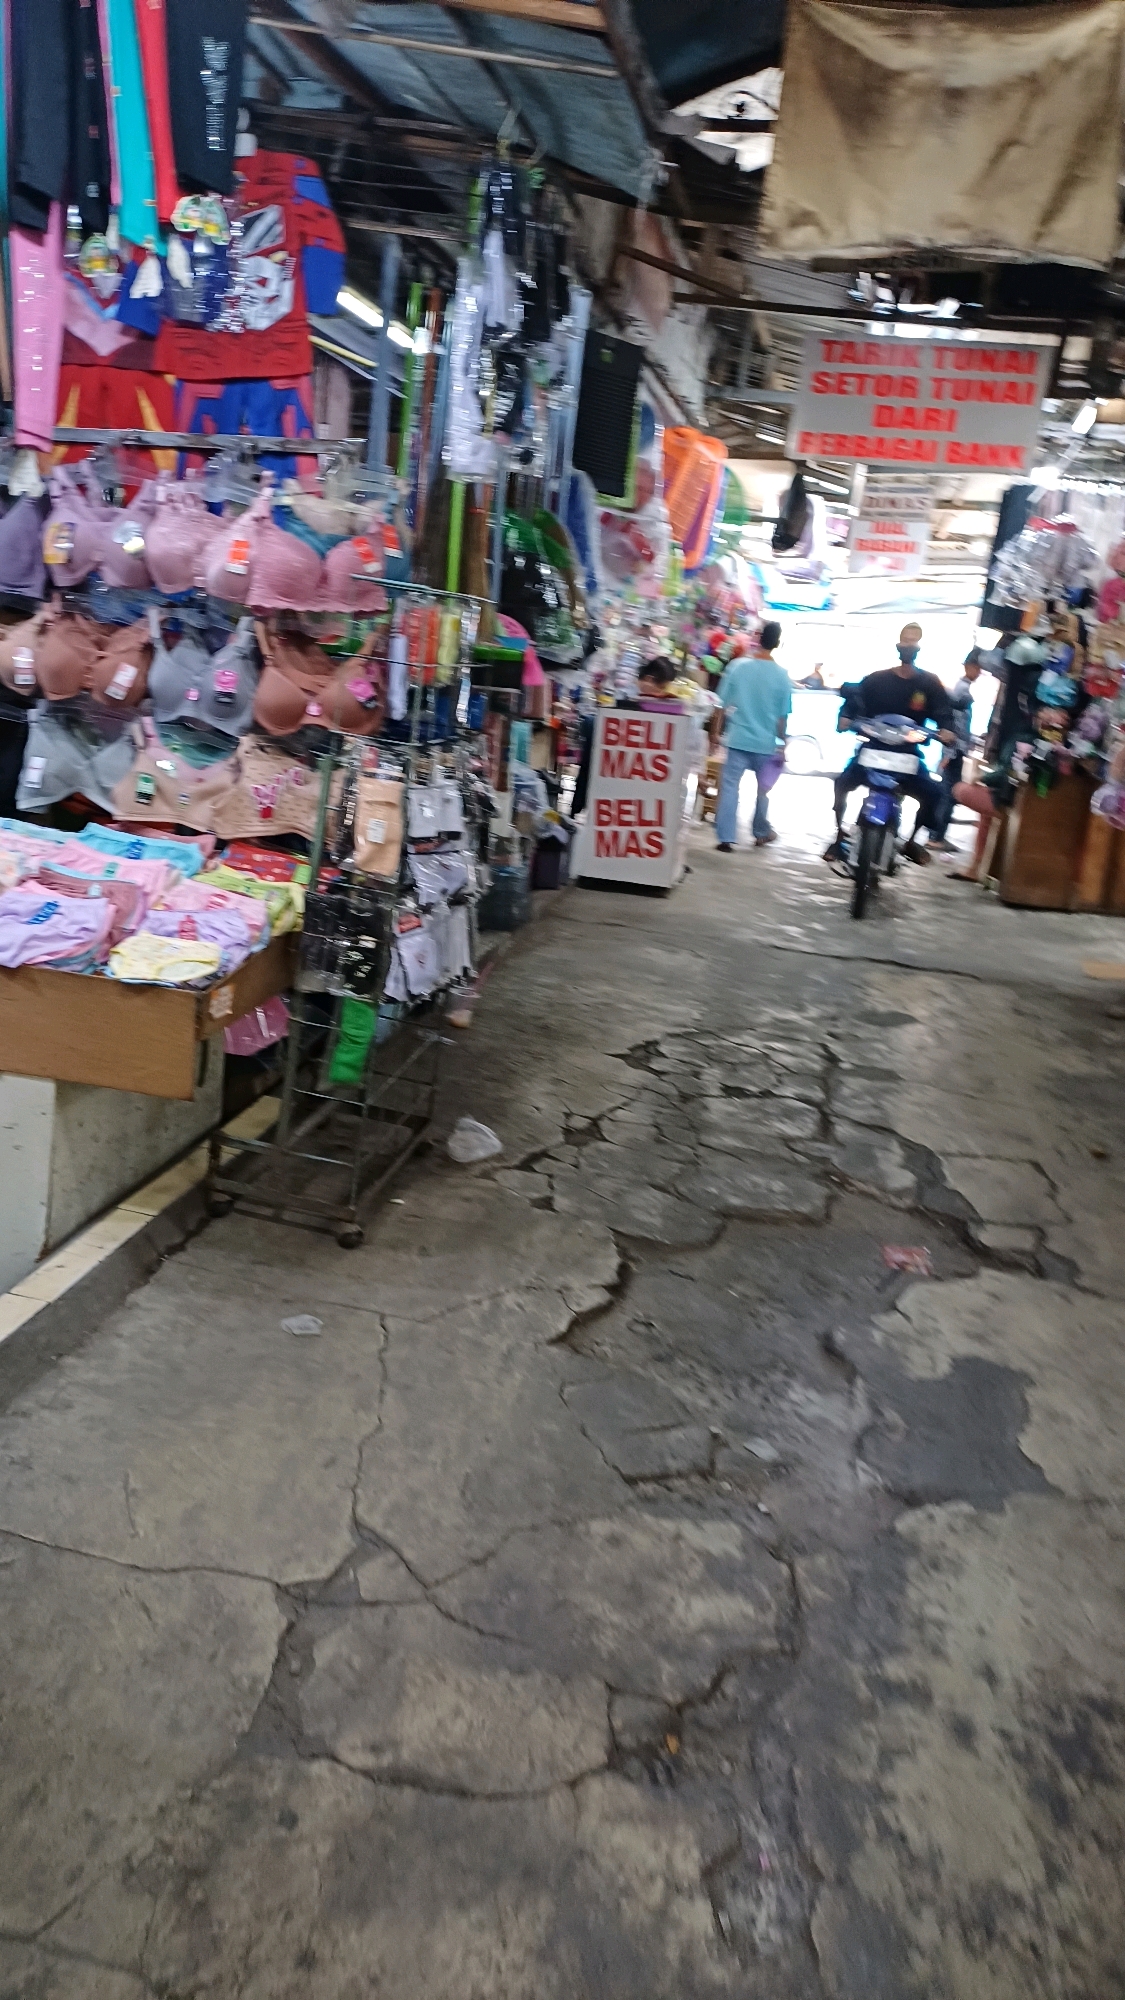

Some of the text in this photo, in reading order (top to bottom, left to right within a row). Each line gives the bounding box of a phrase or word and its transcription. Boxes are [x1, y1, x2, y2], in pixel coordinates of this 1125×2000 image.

[932, 345, 1039, 375] TUNAI
[811, 371, 1036, 406] SETOR TUNAI
[872, 404, 958, 433] DARI
[604, 716, 674, 750] BELI
[599, 749, 670, 783] MAS
[595, 798, 665, 827] BELI
[594, 830, 664, 859] MAS
